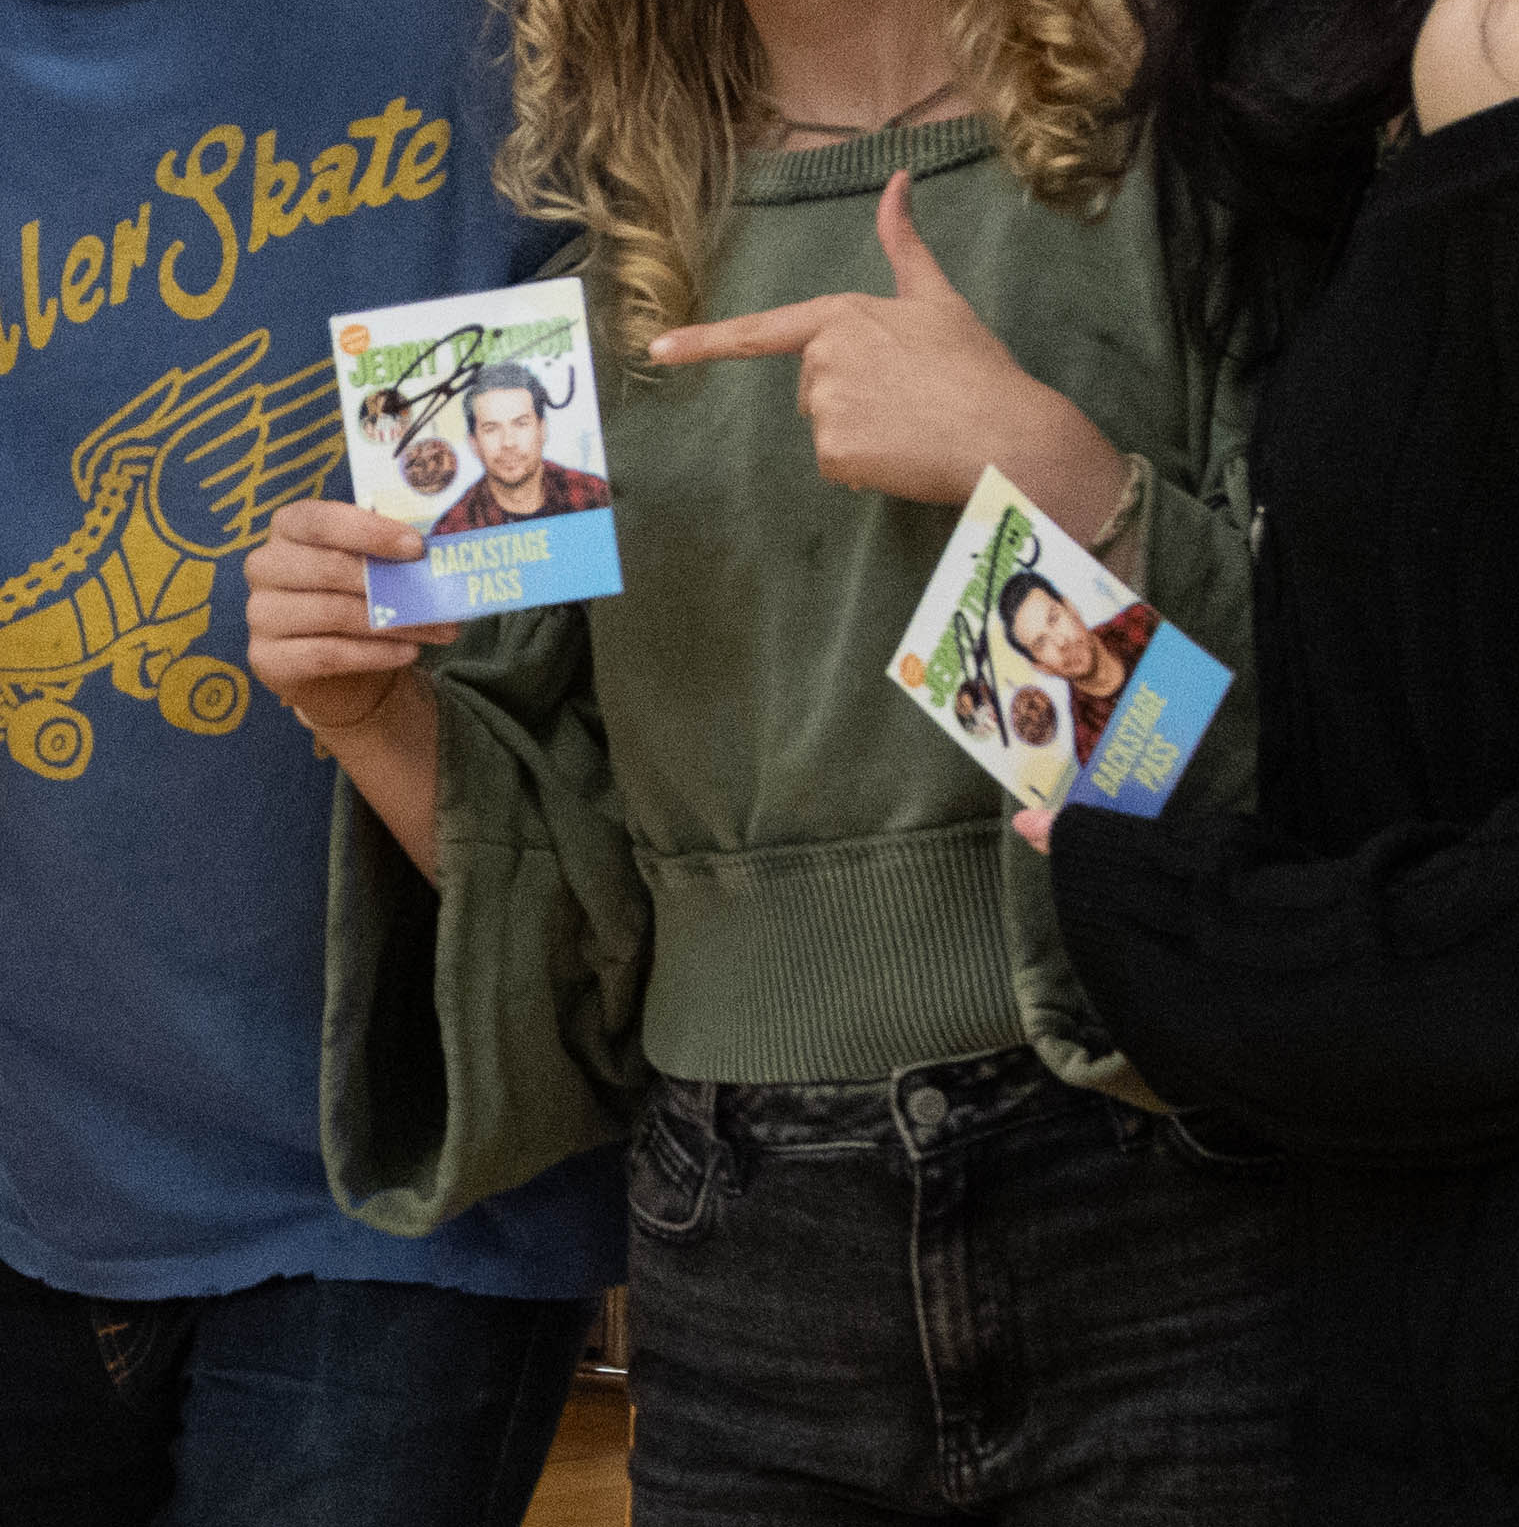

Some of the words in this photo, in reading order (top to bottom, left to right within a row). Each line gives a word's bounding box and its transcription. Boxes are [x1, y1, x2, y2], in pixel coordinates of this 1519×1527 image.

[156, 97, 453, 320] Skate
[429, 528, 551, 578] BACKSTAGE
[466, 569, 524, 606] PASS
[1091, 681, 1169, 798] BACKSTAGE
[1134, 732, 1179, 793] PASS
